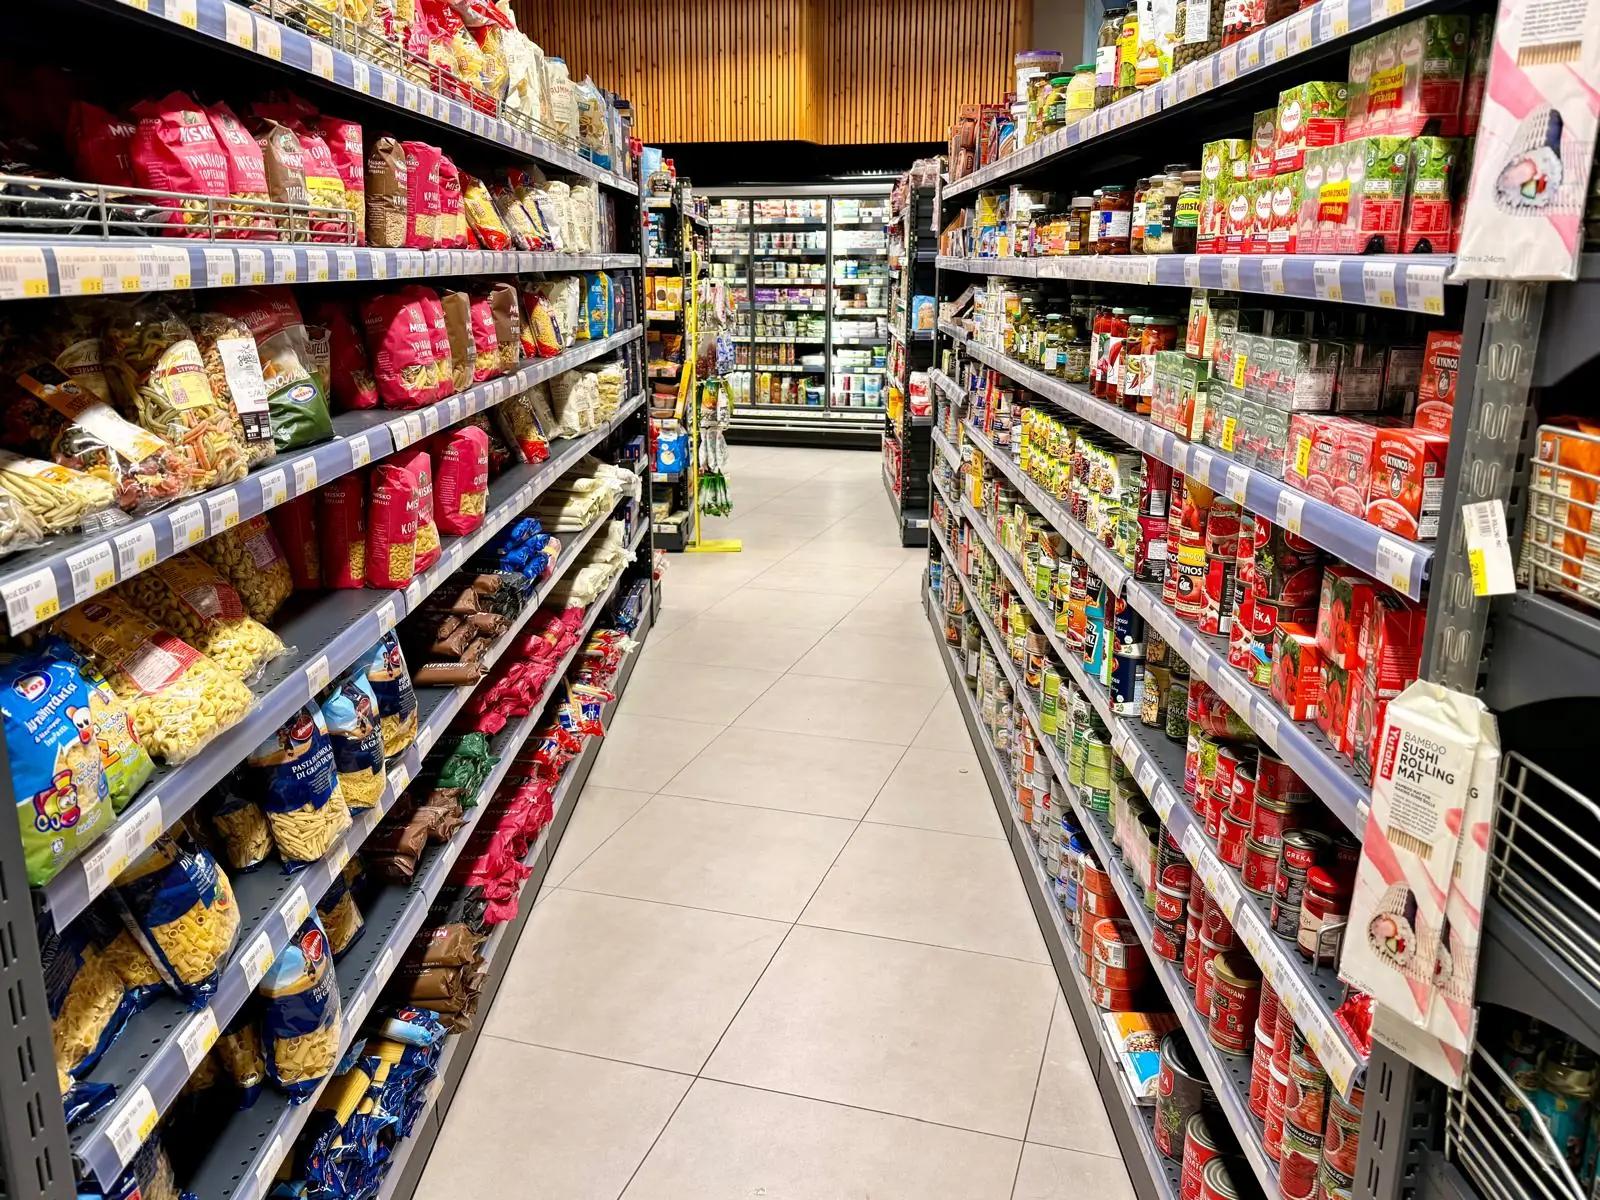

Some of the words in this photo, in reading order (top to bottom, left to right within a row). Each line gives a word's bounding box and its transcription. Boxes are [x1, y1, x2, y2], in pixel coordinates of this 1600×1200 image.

[1381, 729, 1399, 777] Yutaka
[1402, 741, 1439, 765] SUSHI
[1404, 731, 1447, 755] BAMBOO
[1397, 765, 1424, 784] MAT
[1400, 753, 1455, 785] ROLLING
[1286, 850, 1311, 863] GREKA
